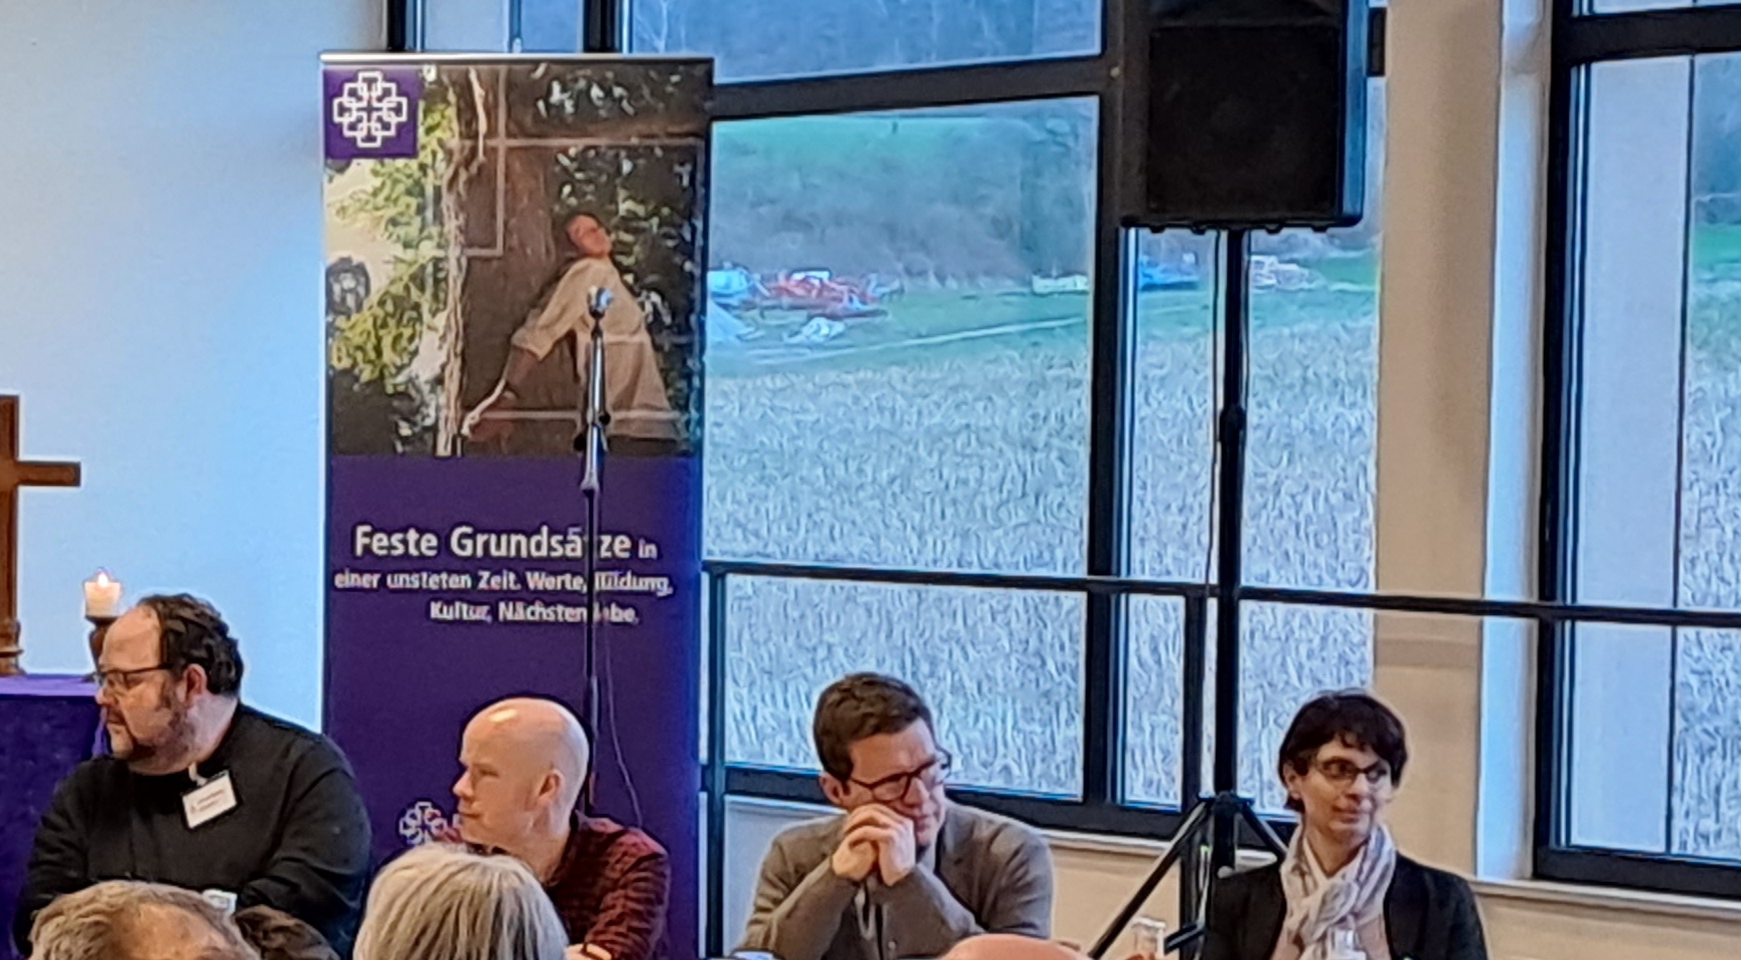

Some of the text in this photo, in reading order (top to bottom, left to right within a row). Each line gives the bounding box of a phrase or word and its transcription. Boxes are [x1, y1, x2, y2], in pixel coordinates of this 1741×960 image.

[355, 525, 658, 559] Feste Grundsäze in
[334, 569, 381, 589] einer
[386, 570, 472, 590] unsteten
[478, 570, 521, 590] Zeit.
[526, 571, 588, 594] Werte,
[430, 600, 492, 624] Kultur,
